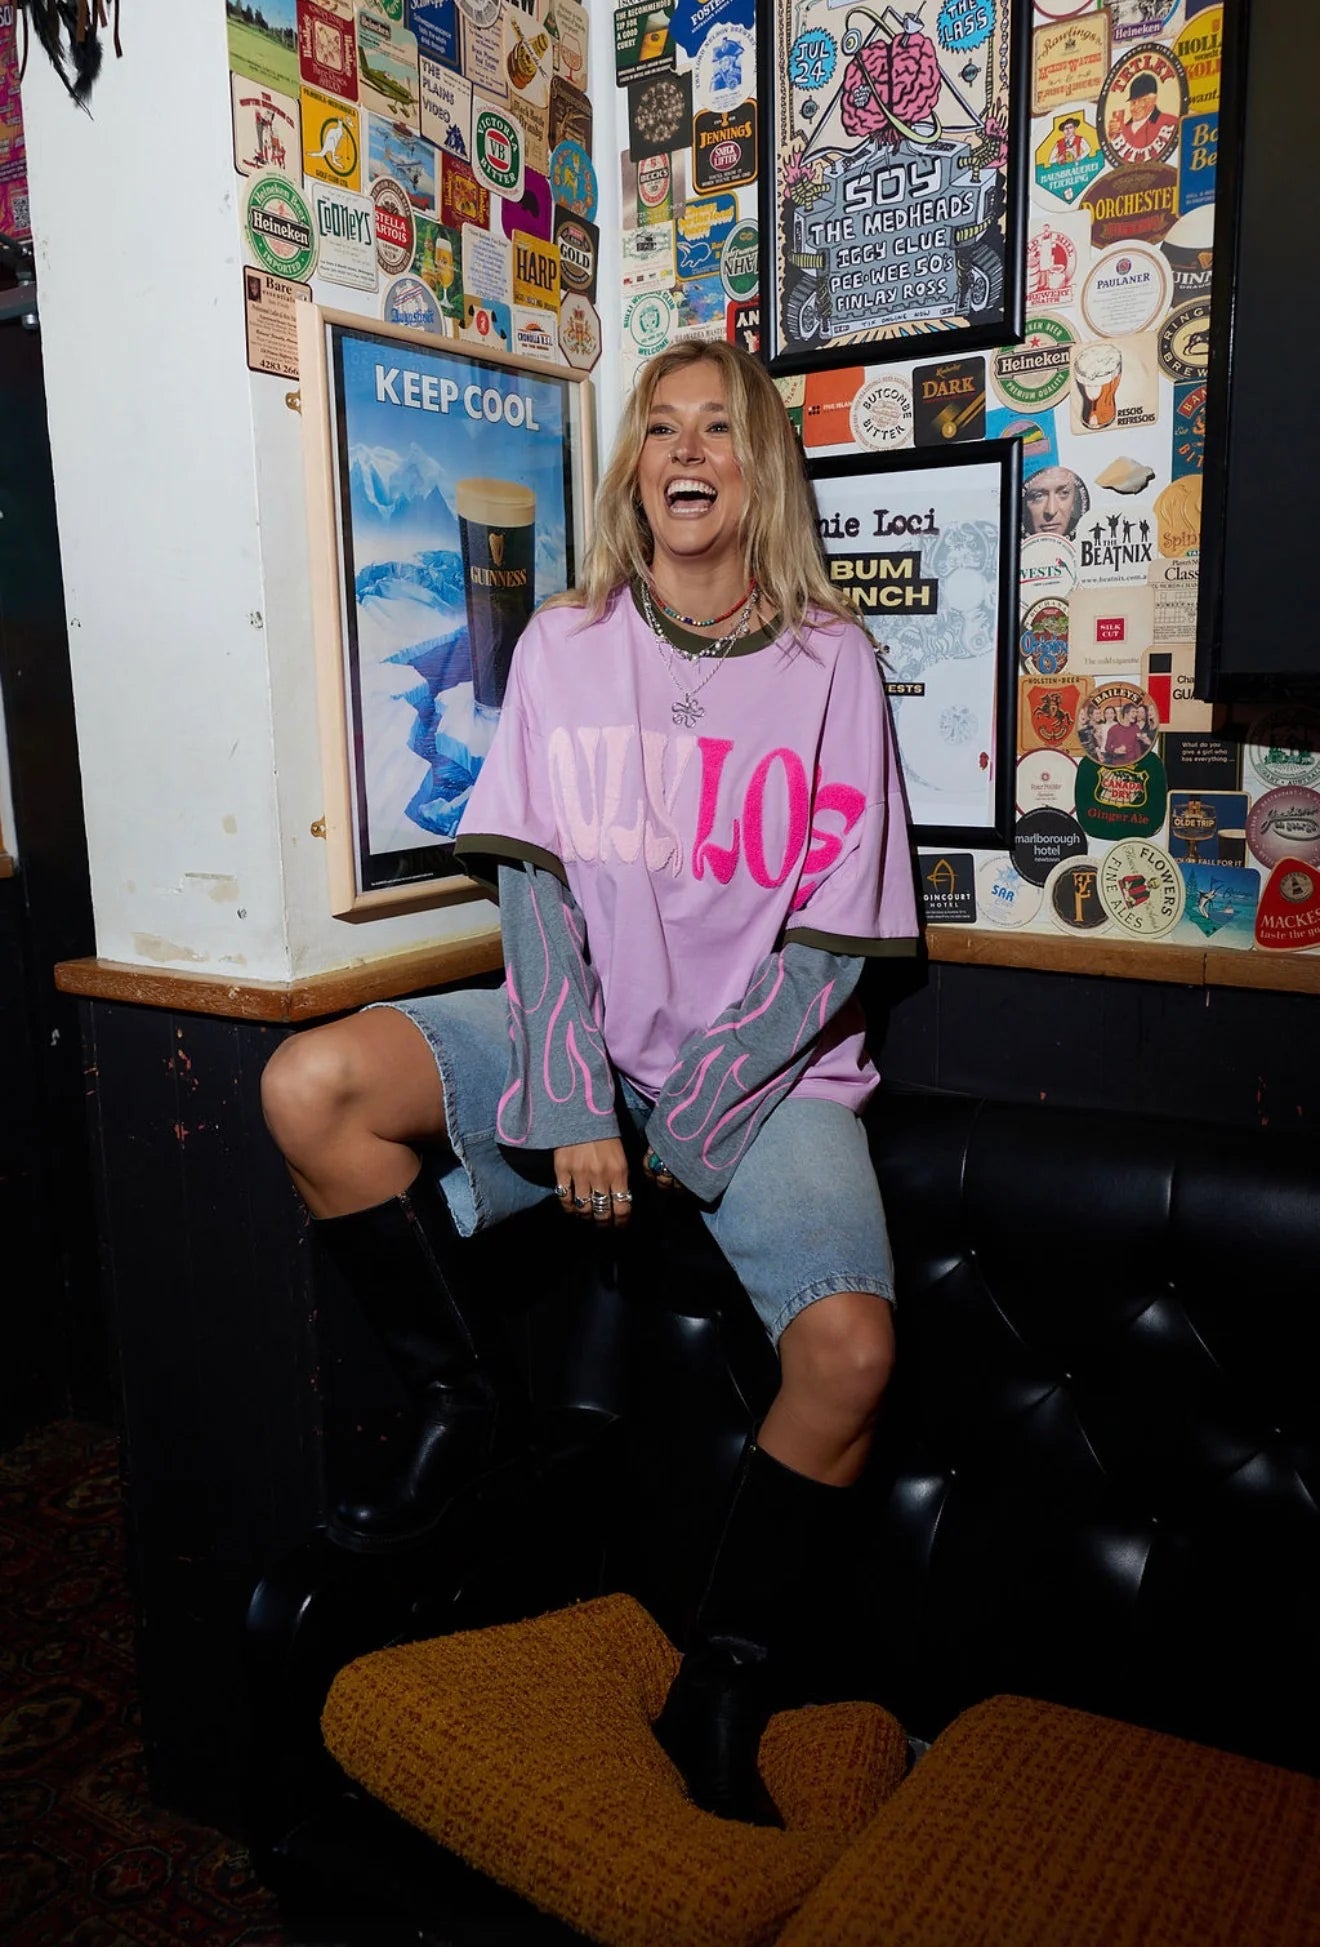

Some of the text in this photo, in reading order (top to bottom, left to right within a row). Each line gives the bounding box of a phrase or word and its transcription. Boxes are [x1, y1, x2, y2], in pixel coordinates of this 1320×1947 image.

[947, 0, 977, 19] THE
[944, 8, 987, 42] LASS
[1114, 23, 1161, 40] Heineken
[797, 41, 829, 62] JUL
[423, 60, 440, 79] THE
[794, 61, 826, 84] 24
[1111, 55, 1175, 93] TETLEY
[422, 77, 455, 105] PLAINS
[422, 96, 451, 123] VIDEO
[478, 117, 518, 152] VICTORIA
[700, 121, 752, 149] JENNINGS
[1111, 124, 1175, 163] BITTER
[490, 139, 505, 160] VB
[480, 158, 517, 184] BITTER
[844, 157, 942, 214] SOY
[252, 211, 309, 246] Heineken
[375, 212, 406, 232] STELLA
[811, 191, 975, 246] THE MEDHEADS
[376, 222, 407, 243] ARTOIS
[560, 243, 590, 268] GOLD
[837, 229, 947, 269] IGGY CLUE
[1055, 234, 1074, 258] MILL
[263, 251, 301, 273] IMPORTED
[516, 246, 557, 291] HARP
[266, 276, 292, 295] Bare
[1096, 272, 1151, 289] PAULANER
[836, 278, 949, 312] FINLAY ROSS
[638, 338, 670, 356] WELCOME
[260, 360, 281, 370] 4283
[1001, 351, 1070, 373] Heineken
[375, 363, 540, 431] KEEP COOL
[922, 376, 976, 400] DARK
[1005, 373, 1065, 399] PREMIUM QUALITY
[862, 388, 912, 419] BUTCOMBE
[1117, 406, 1143, 416] RESCHS
[863, 418, 905, 441] BITTER
[1117, 413, 1156, 426] REFRESCHS
[872, 507, 940, 537] Loci
[1081, 540, 1152, 572] BEATNIX
[471, 565, 527, 588] GUINNESS
[830, 558, 913, 581] BUM
[1100, 623, 1121, 631] SILK
[1101, 630, 1120, 638] CUT
[1095, 688, 1138, 704] BAILEYS
[1102, 779, 1142, 791] CANADA
[1111, 790, 1132, 798] DRY
[1087, 807, 1150, 824] Ginger Ale
[1174, 818, 1215, 828] OLDE TRIP
[1016, 833, 1080, 846] marlborough
[1034, 845, 1060, 855] hotel
[1105, 857, 1143, 928] FINE ALES
[1139, 846, 1176, 917] FLOWERS
[1289, 928, 1306, 939] the
